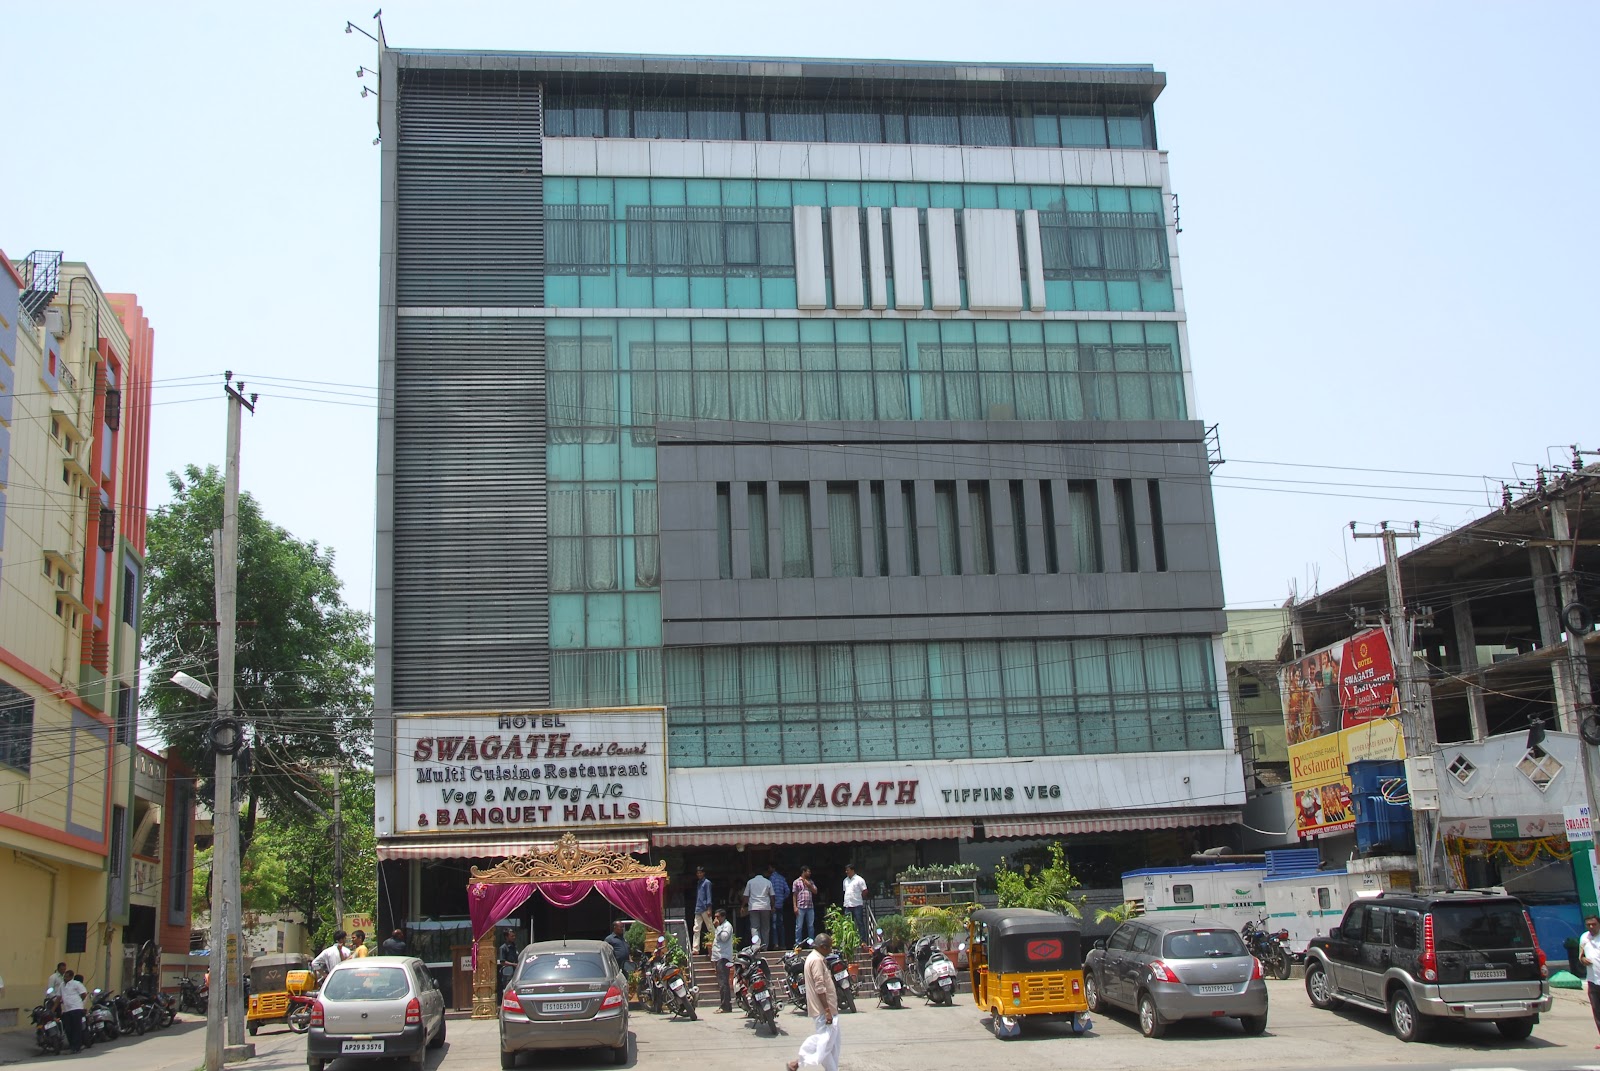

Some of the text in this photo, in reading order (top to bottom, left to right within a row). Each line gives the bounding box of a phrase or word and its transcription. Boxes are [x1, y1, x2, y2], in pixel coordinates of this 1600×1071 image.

[1357, 657, 1373, 668] HOTEL
[1344, 667, 1374, 686] SWAGATH
[498, 714, 565, 729] HOTEL
[414, 732, 647, 762] SWAGATH East Court
[417, 761, 648, 783] Multi Cuisine Restaurant
[1293, 752, 1345, 778] Restaurant
[442, 783, 624, 806] Veg & Non Veg A/C
[764, 780, 1062, 810] SWAGATH TIFFINS VEG
[418, 802, 641, 827] & BANQUET HALLS
